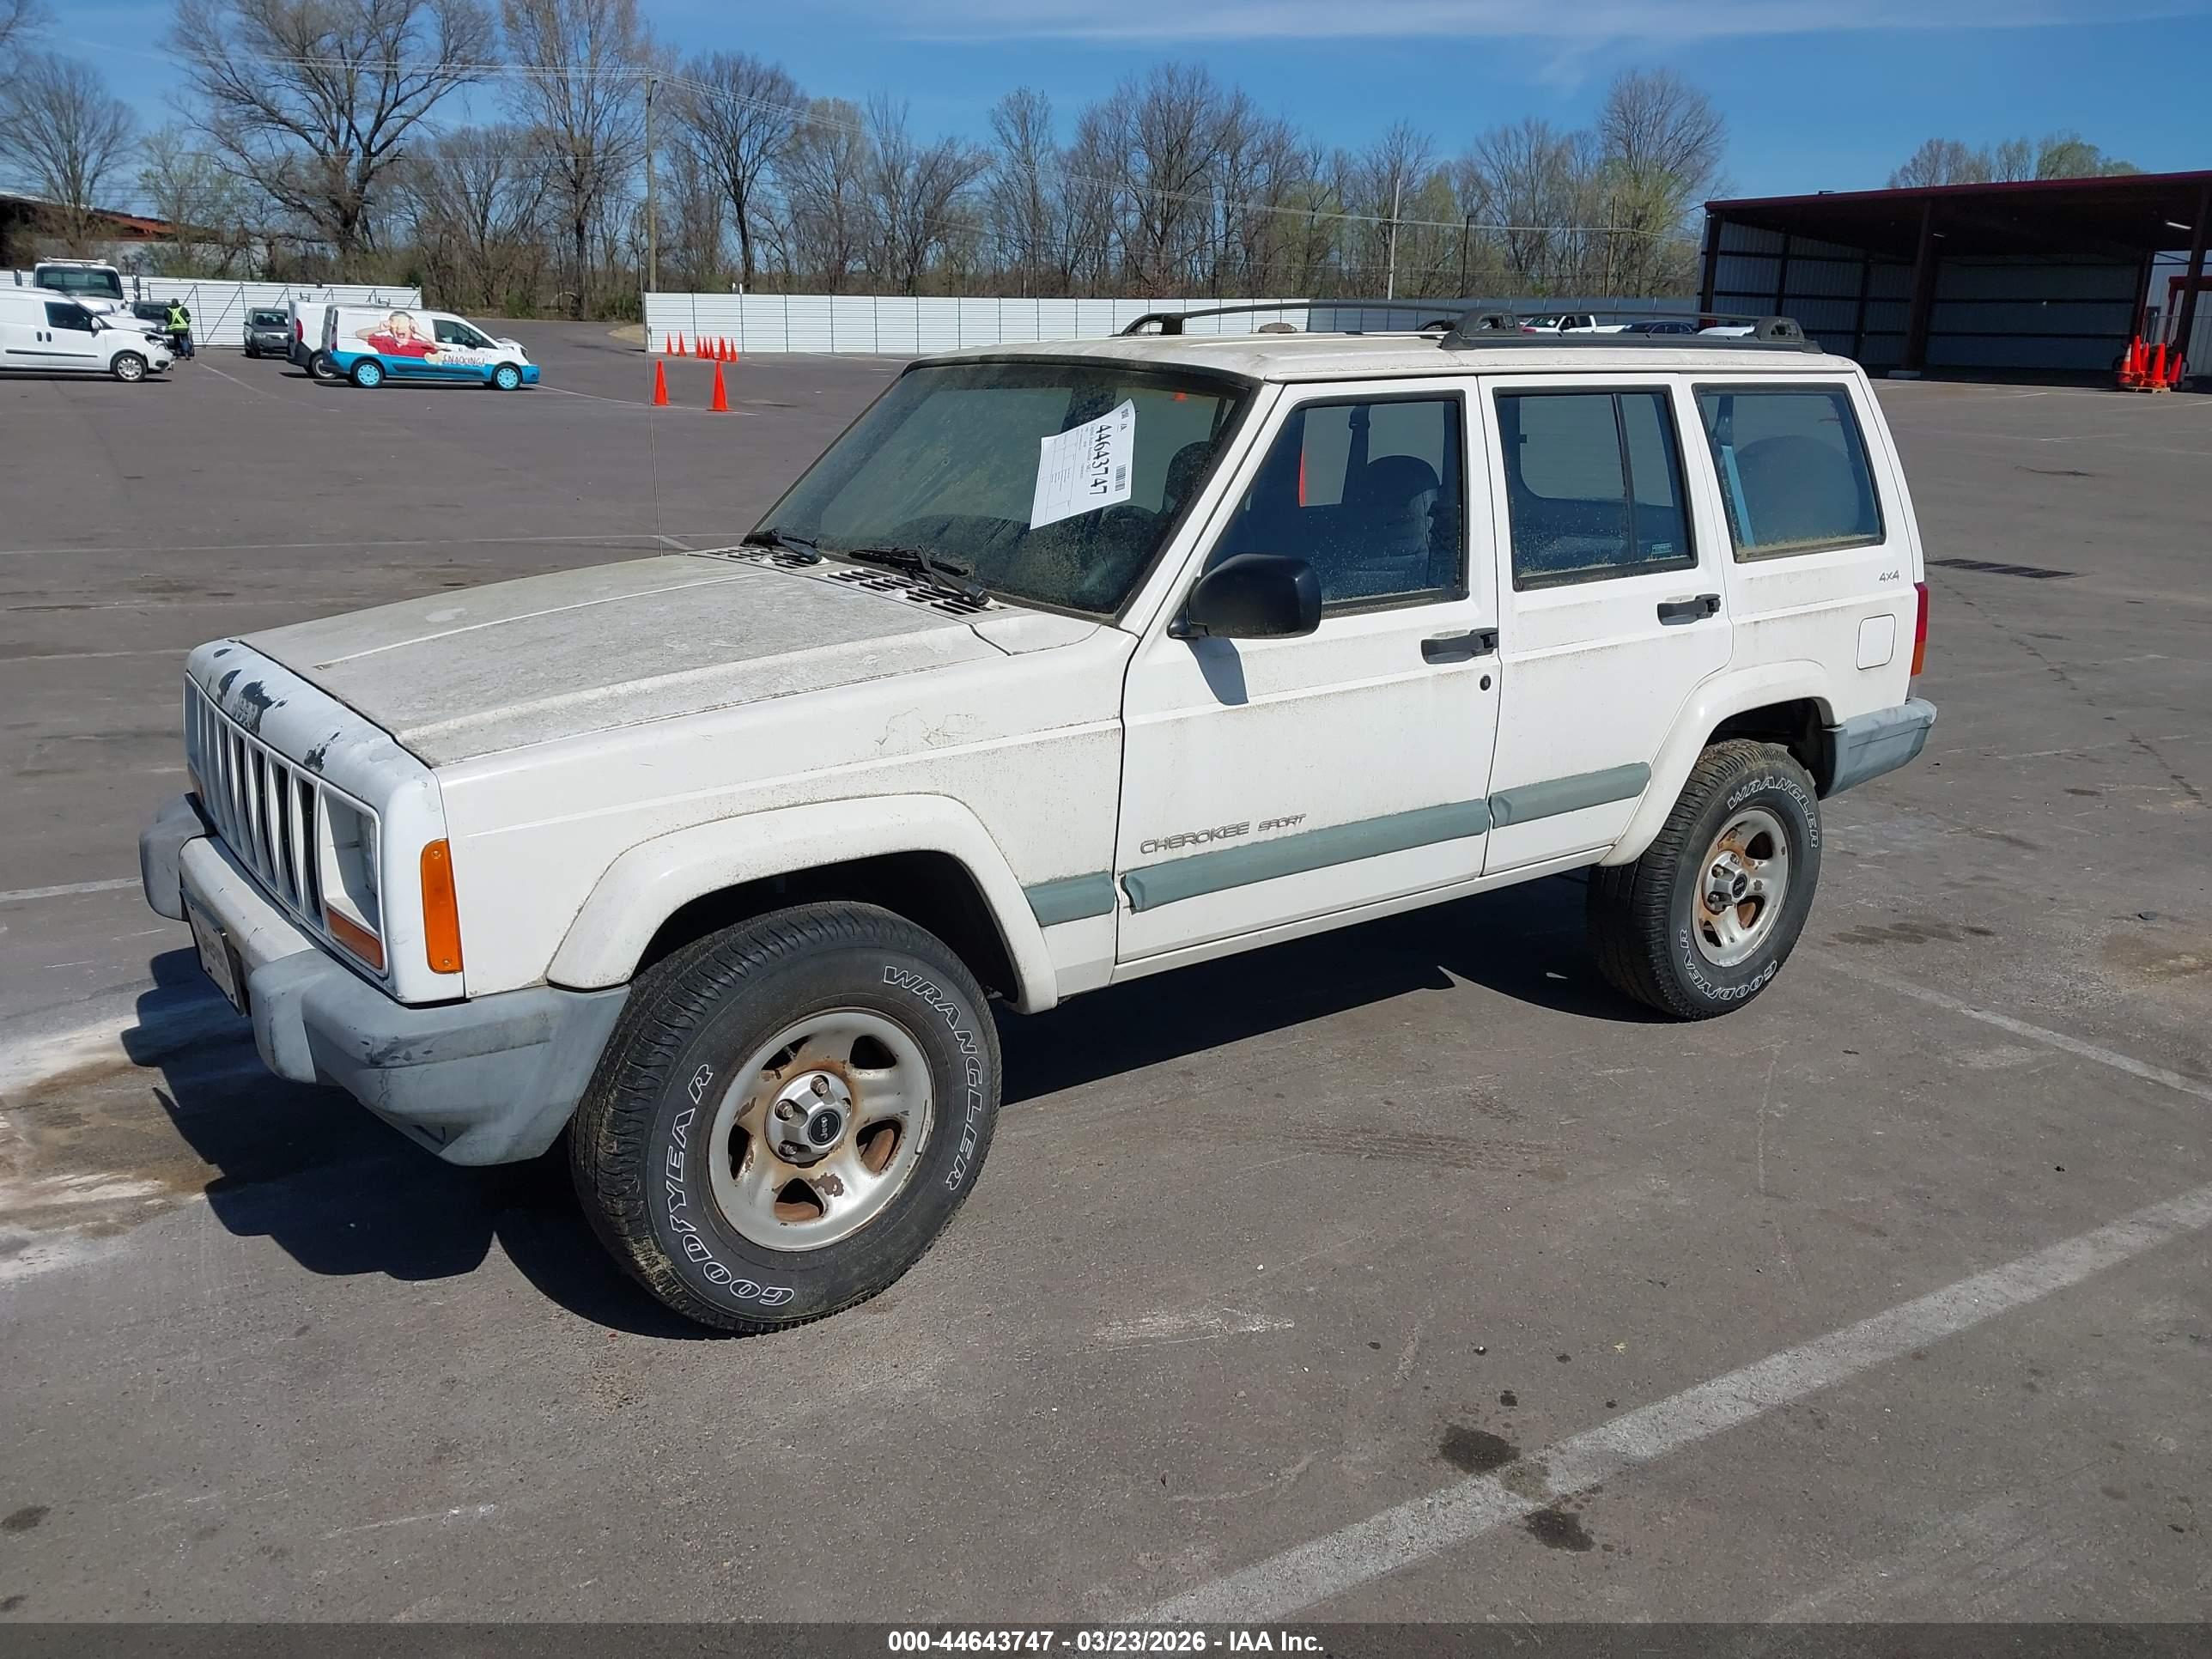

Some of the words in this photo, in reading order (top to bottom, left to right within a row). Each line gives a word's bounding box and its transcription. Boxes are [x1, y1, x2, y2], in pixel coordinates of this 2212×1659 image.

[1089, 424, 1114, 495] 44643747
[1139, 821, 1250, 854] CHEROKEE
[1257, 813, 1307, 832] SPORT
[1727, 775, 1819, 849] WRANGLER
[1679, 928, 1778, 1000] GOODYEAR
[883, 965, 982, 1191] WRANGLER
[820, 1116, 829, 1139] Jeep
[665, 1063, 794, 1306] GOODYEAR
